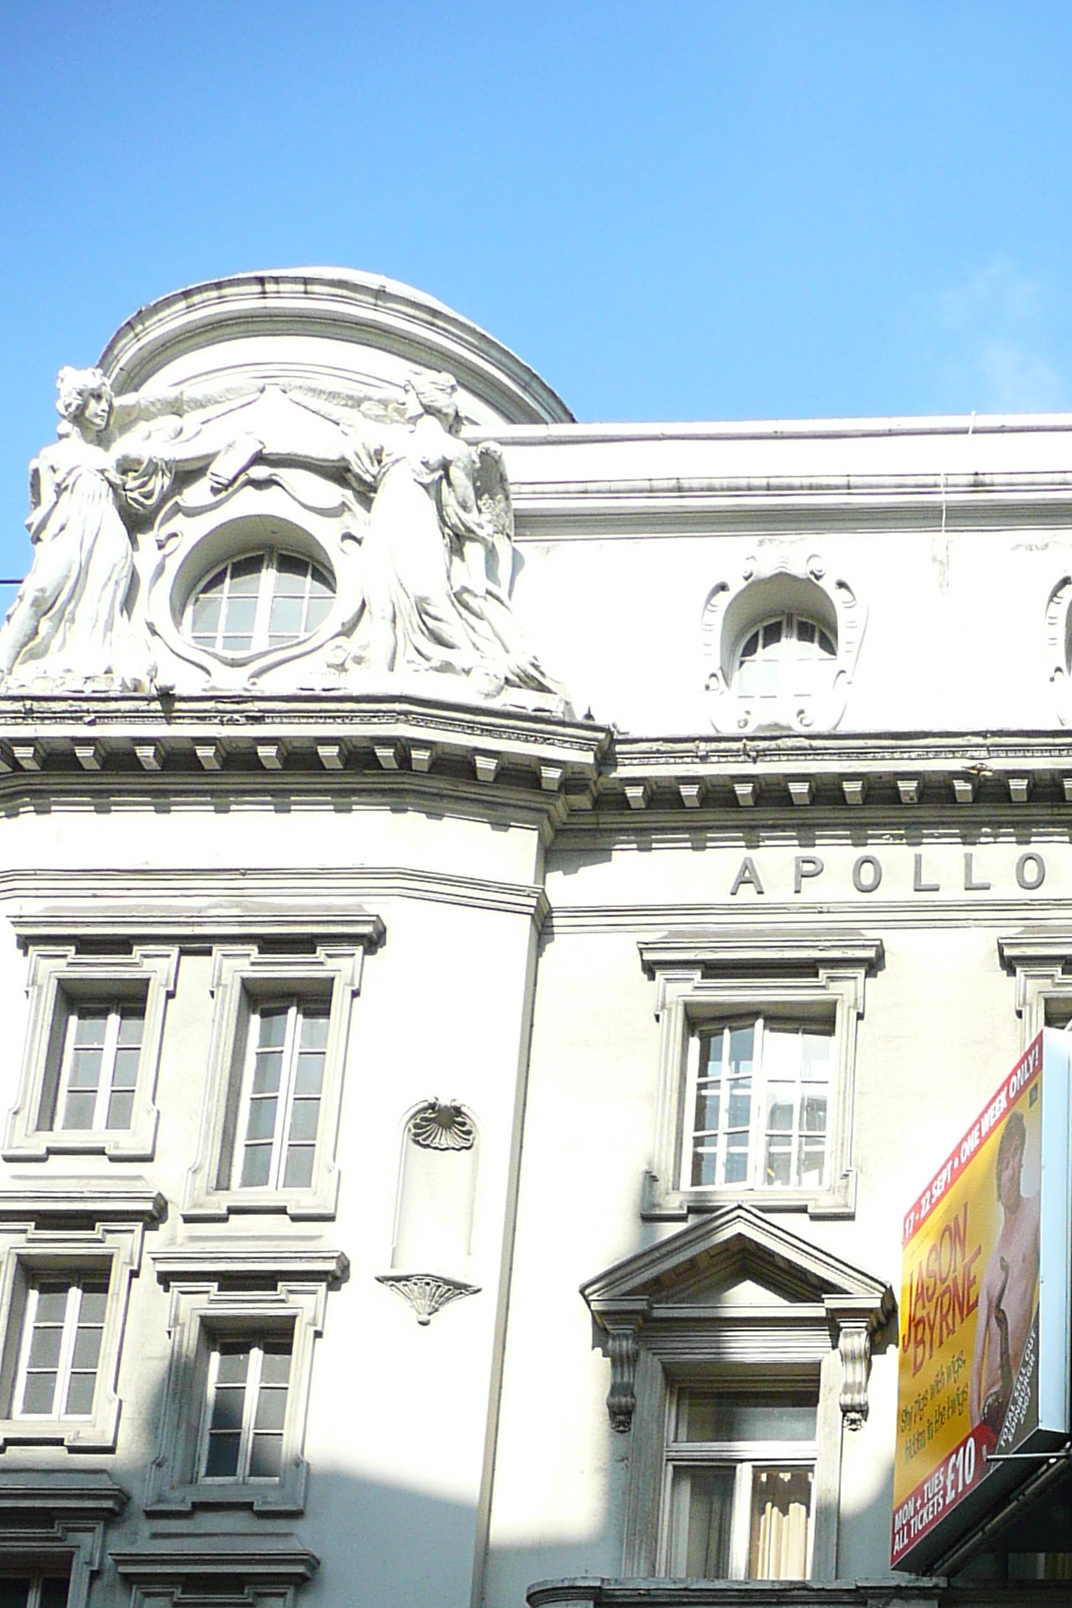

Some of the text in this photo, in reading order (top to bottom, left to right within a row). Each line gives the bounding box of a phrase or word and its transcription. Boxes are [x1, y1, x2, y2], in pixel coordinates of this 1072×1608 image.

[729, 851, 1047, 896] APOLLO
[904, 1218, 915, 1238] 17
[920, 1194, 932, 1220] 22
[931, 1158, 953, 1202] SEPT
[961, 1123, 981, 1163] ONE
[980, 1086, 1008, 1138] WEEK
[1009, 1044, 1040, 1099] ONLY!
[902, 1202, 968, 1353] JASON
[911, 1244, 981, 1377] BYRNE
[1000, 1329, 1037, 1447] TOTAL SELL OUT
[1009, 1357, 1036, 1444] EDINBURGH
[1019, 1387, 1033, 1425] 2007
[895, 1495, 914, 1533] MON
[923, 1465, 945, 1501] TUES
[944, 1436, 976, 1506] £10
[893, 1492, 944, 1556] ALL TICKETS
